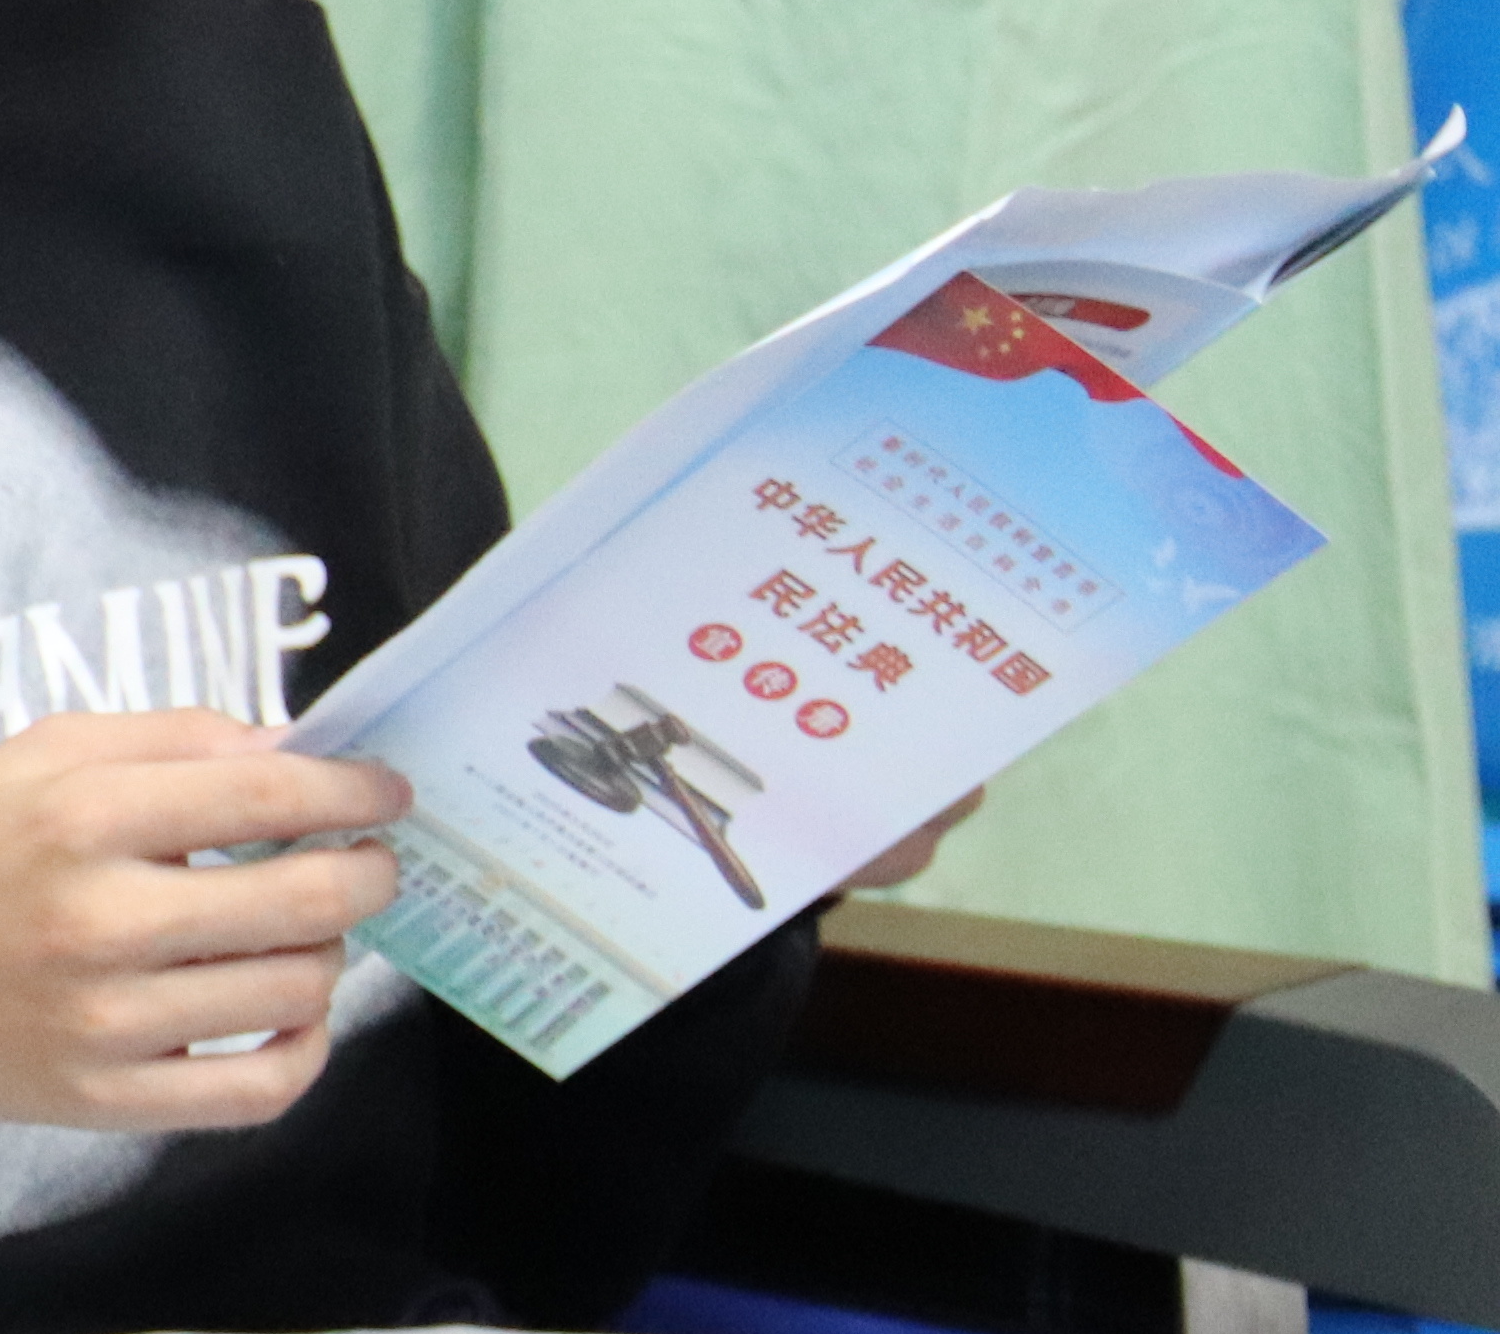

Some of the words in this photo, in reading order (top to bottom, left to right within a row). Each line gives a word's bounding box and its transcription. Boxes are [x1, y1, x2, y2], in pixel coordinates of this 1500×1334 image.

[747, 568, 914, 693] 民法典
[752, 477, 1052, 697] 中华人民共和国
